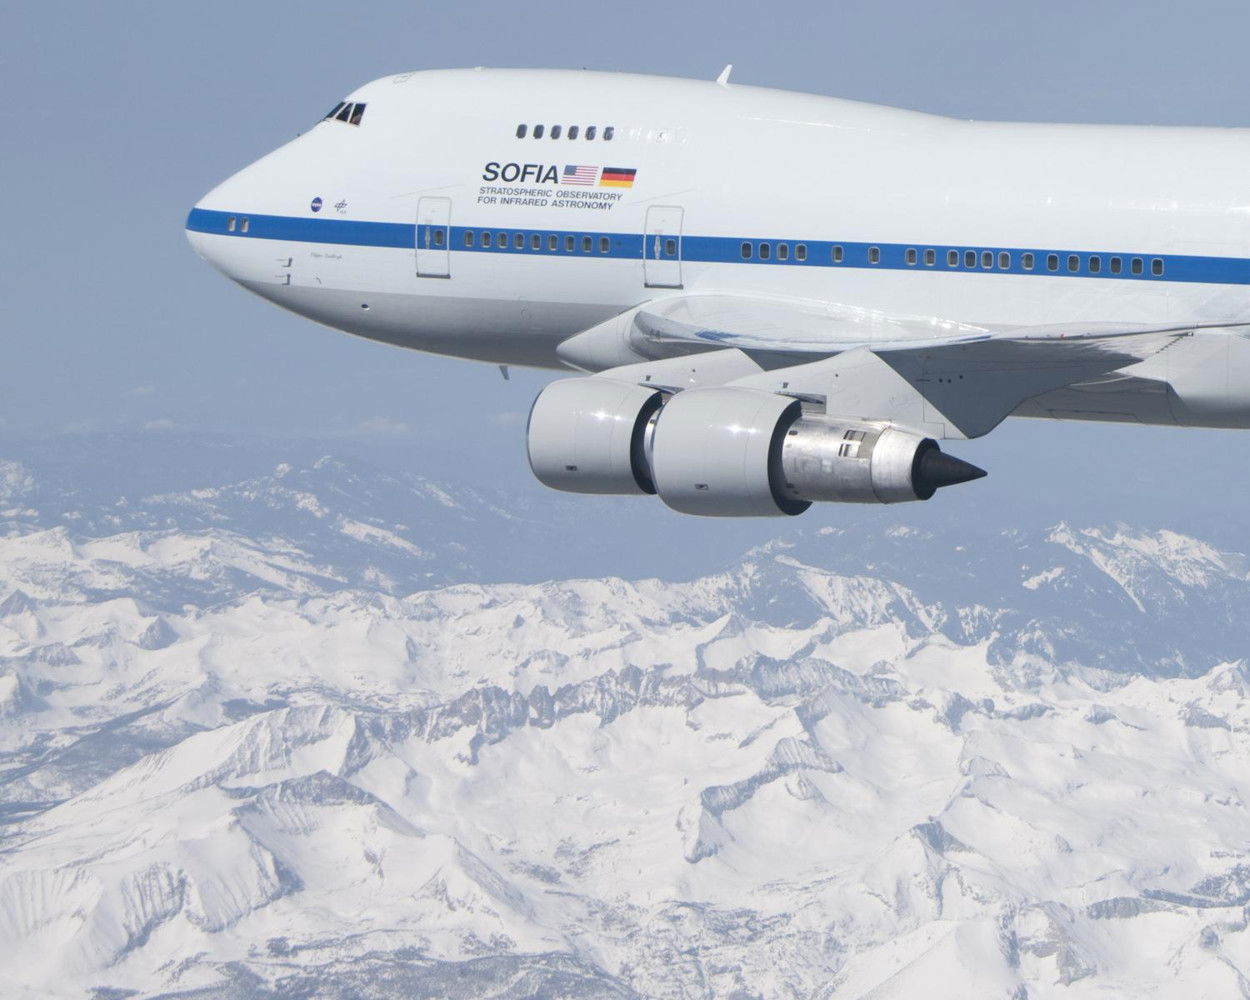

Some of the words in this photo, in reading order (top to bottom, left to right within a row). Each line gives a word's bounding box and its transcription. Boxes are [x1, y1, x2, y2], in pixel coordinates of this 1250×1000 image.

[482, 162, 559, 184] SOFIA
[479, 187, 552, 197] STRATOSPHERIC
[556, 190, 623, 200] OBSERVATORY
[477, 196, 498, 205] FOR
[500, 197, 548, 207] INFRARED
[551, 200, 613, 210] ASTRONOMY
